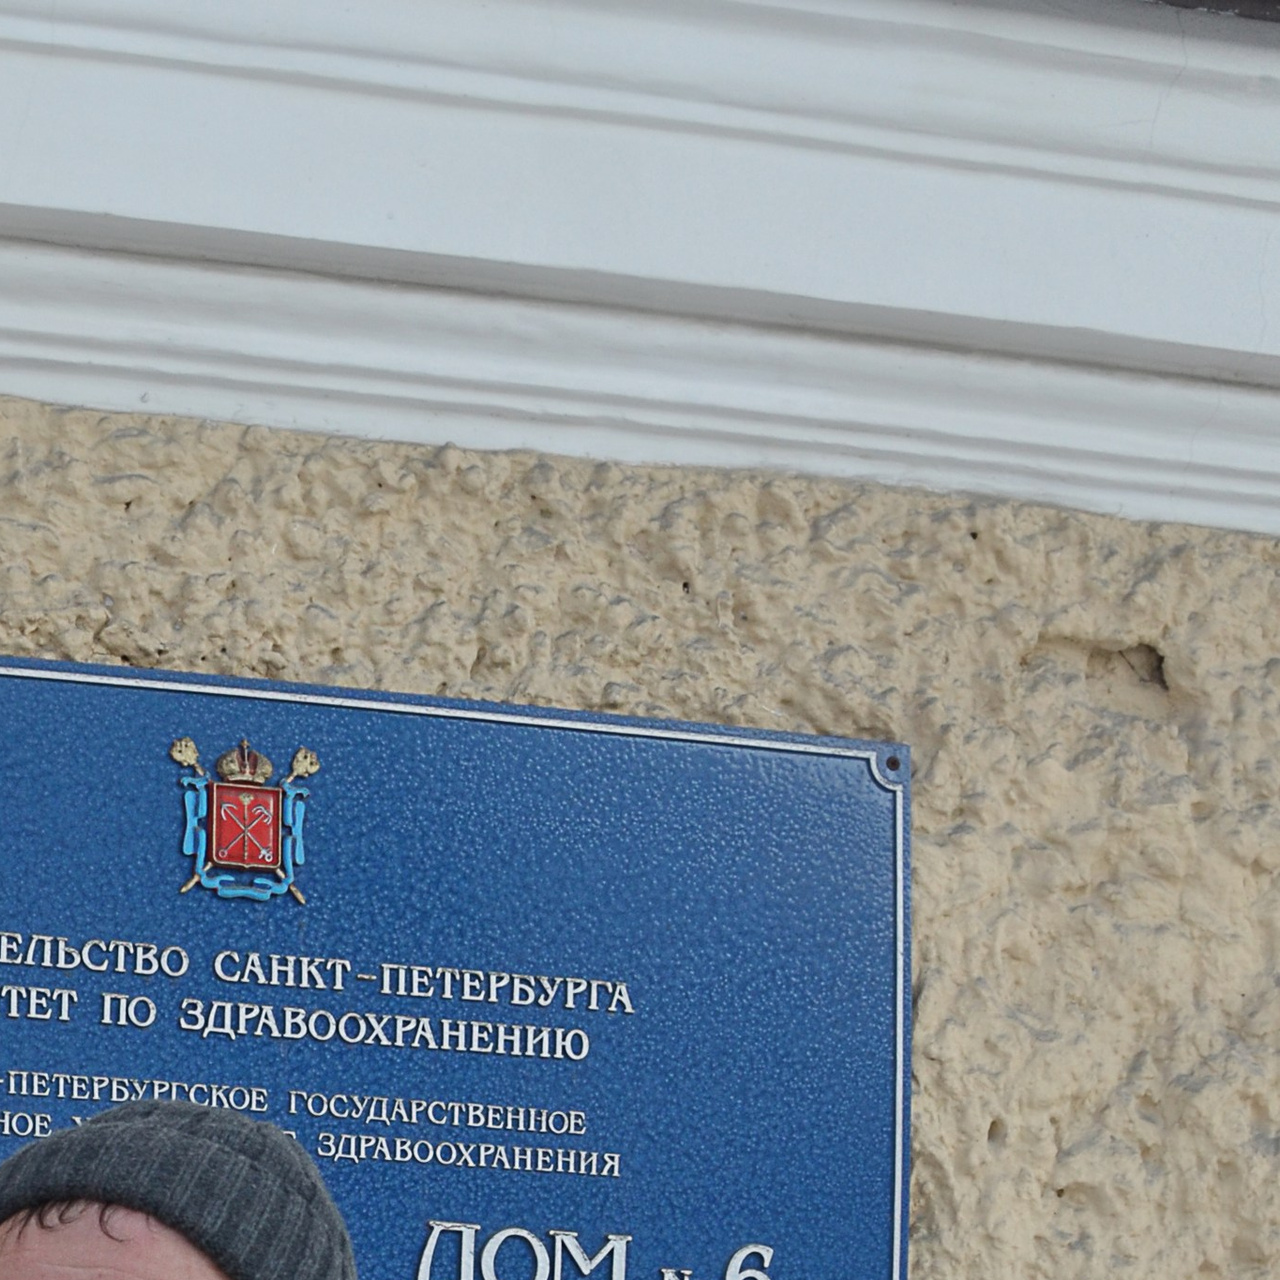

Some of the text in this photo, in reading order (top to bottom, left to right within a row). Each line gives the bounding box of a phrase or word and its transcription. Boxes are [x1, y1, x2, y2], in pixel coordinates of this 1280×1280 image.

[213, 950, 635, 1014] САНКТ-ПЕТЕРБУРГА
[101, 992, 157, 1027] ПО
[179, 996, 590, 1060] ЗДРАВООХРАНЕНИЮ
[288, 1090, 587, 1136] ГОСУДАРСТВЕННОЕ
[317, 1132, 621, 1177] ЗДРАВООХРАНЕНИЯ
